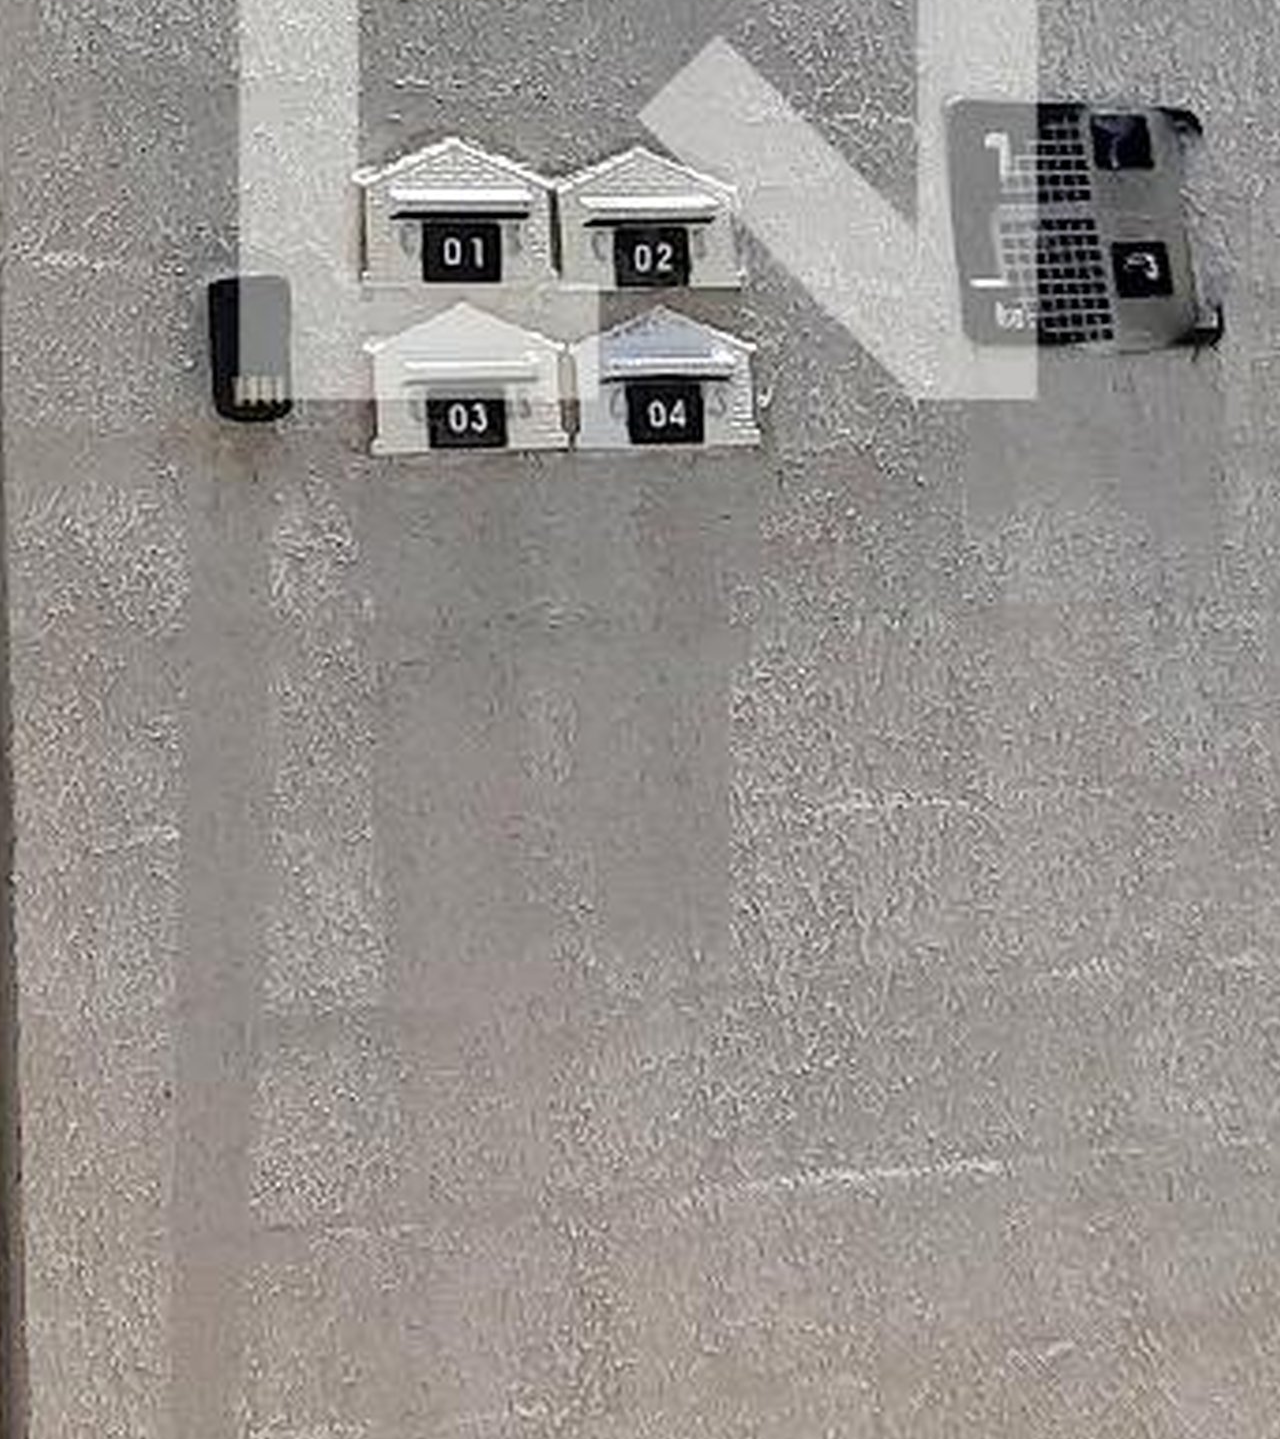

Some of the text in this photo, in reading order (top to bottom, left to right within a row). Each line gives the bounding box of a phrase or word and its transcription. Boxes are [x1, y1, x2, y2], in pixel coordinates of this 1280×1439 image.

[443, 236, 485, 268] 01
[633, 242, 673, 272] 02
[447, 402, 488, 433] 03
[647, 399, 687, 429] 04
